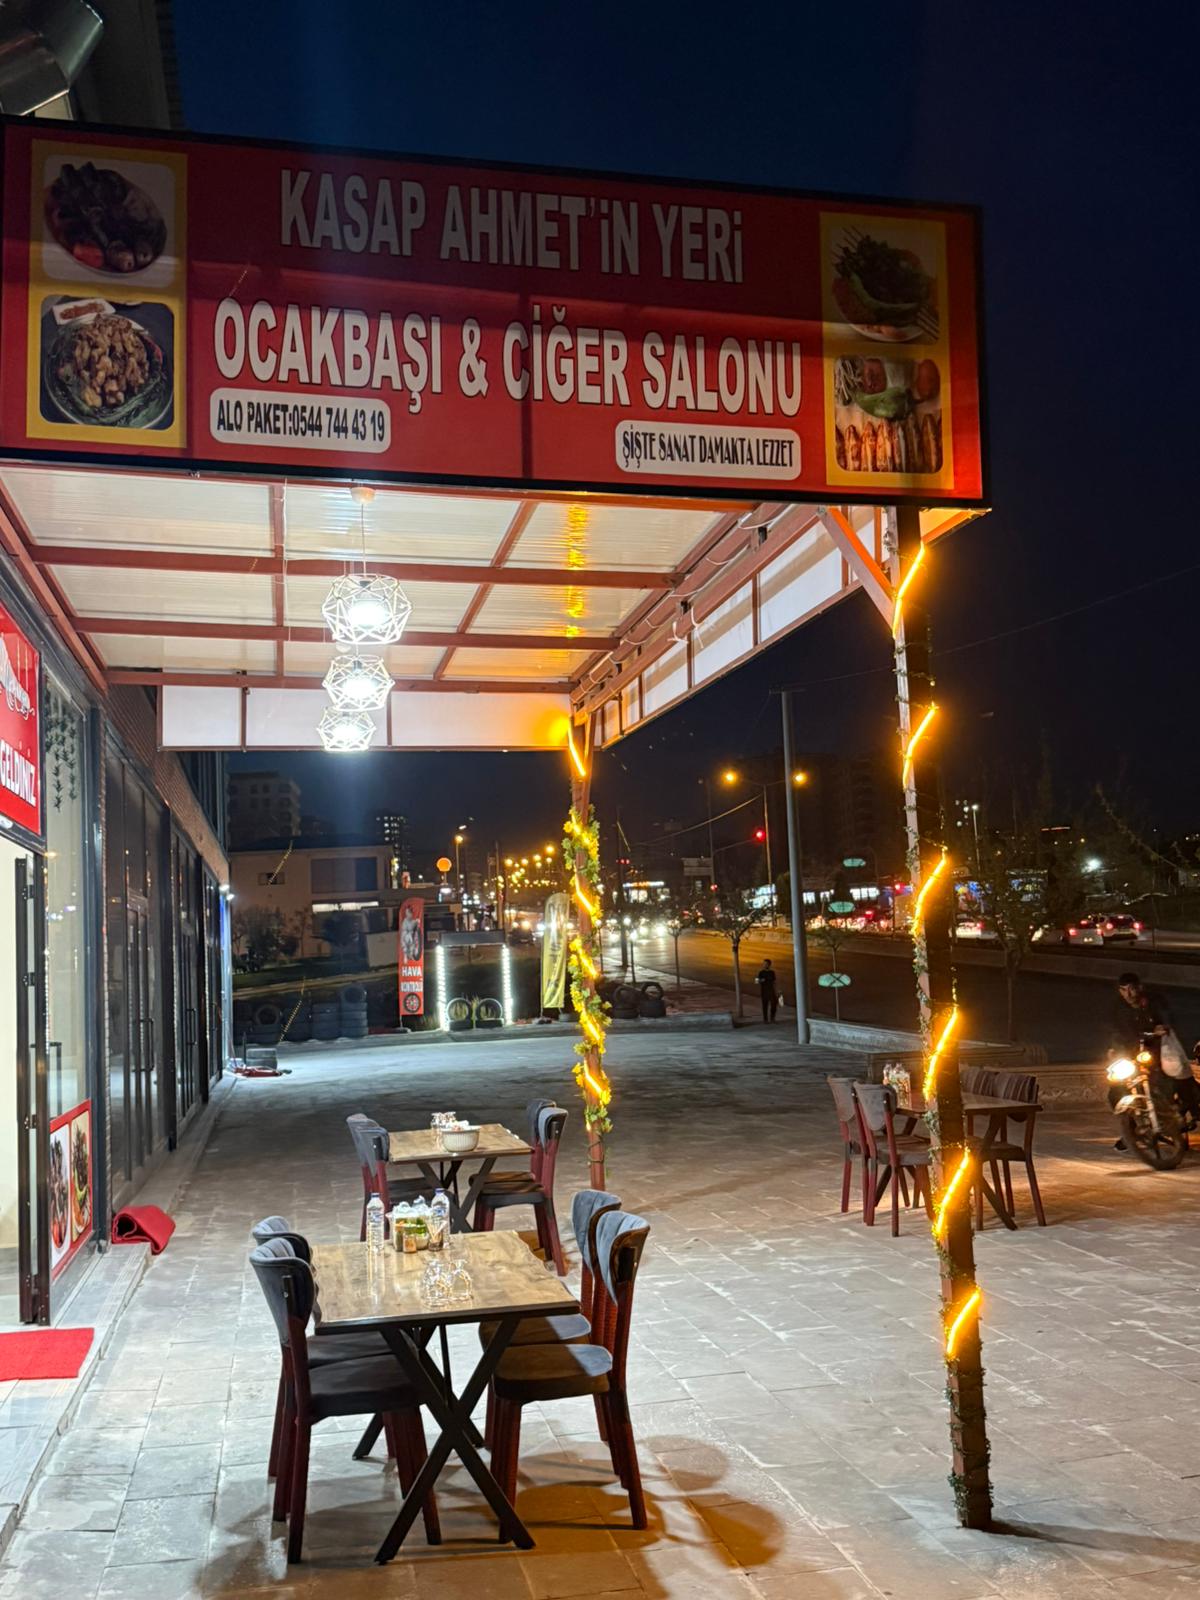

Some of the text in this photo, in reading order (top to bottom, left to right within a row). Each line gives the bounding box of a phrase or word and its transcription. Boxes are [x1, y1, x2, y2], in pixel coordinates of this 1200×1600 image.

[280, 168, 427, 257] KASAP
[214, 297, 802, 417] OCAKBAŞI & CİĞER SALONU
[217, 399, 243, 433] ALO
[325, 407, 349, 440] 744
[351, 408, 367, 441] 43
[370, 409, 385, 442] 19
[622, 424, 794, 468] ŞİŞTE SANAT DAMAKTA LEZZET
[401, 965, 423, 977] HAVA
